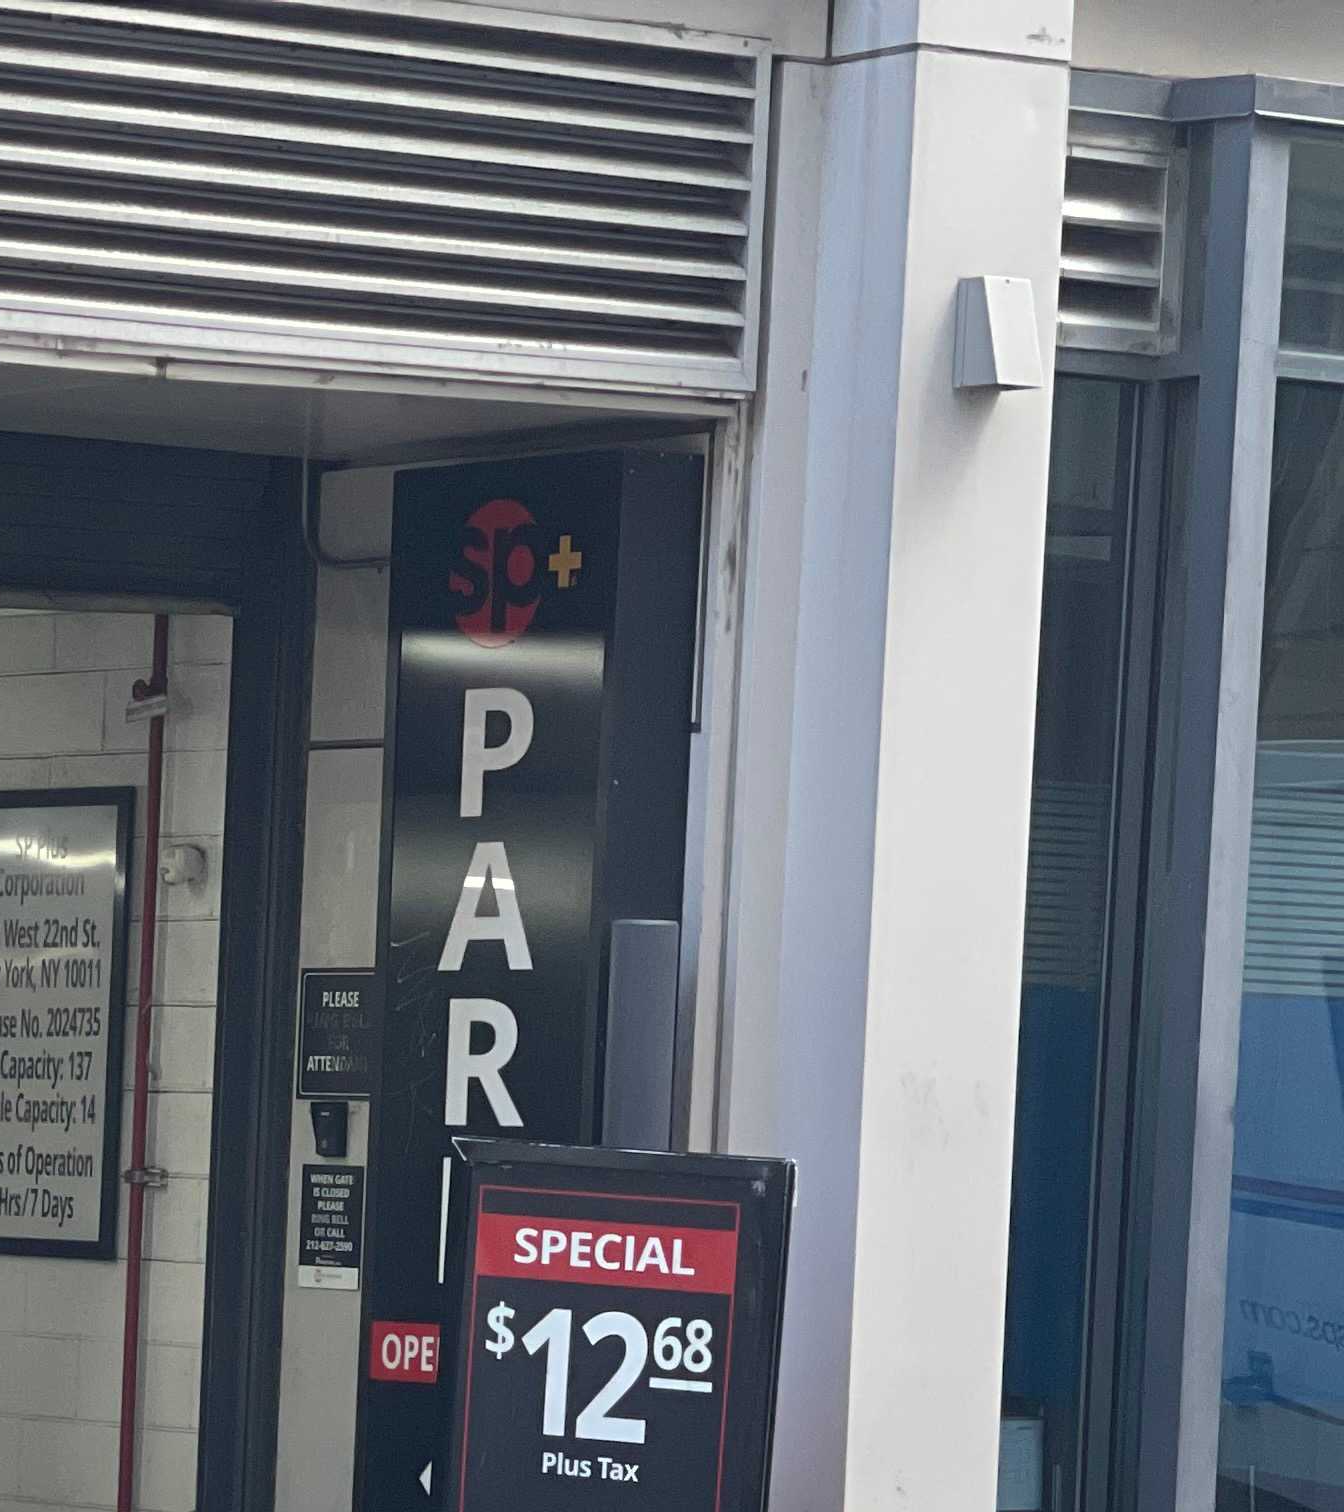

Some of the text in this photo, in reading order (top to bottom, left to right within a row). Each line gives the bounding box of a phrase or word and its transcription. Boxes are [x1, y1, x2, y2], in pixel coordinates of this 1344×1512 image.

[4, 919, 40, 948] West
[43, 917, 79, 948] 22nd
[82, 918, 100, 948] St.
[4, 956, 37, 992] York,
[40, 958, 61, 988] NY
[65, 958, 101, 988] 10011
[437, 686, 536, 1285] PAR
[322, 991, 360, 1007] PLEASE
[21, 1008, 43, 1038] No.
[46, 1007, 101, 1038] 2024735
[0, 1048, 63, 1089] Capacity:
[69, 1051, 93, 1081] 137
[16, 1092, 77, 1132] Capacity:
[81, 1094, 96, 1125] 14
[7, 1143, 23, 1174] of
[25, 1146, 93, 1184] Operation
[41, 1188, 74, 1227] Days
[317, 1199, 345, 1211] PLEASE
[514, 1227, 695, 1277] SPECIAL
[381, 1333, 440, 1373] OPE
[541, 1452, 639, 1483] Plus Tax
